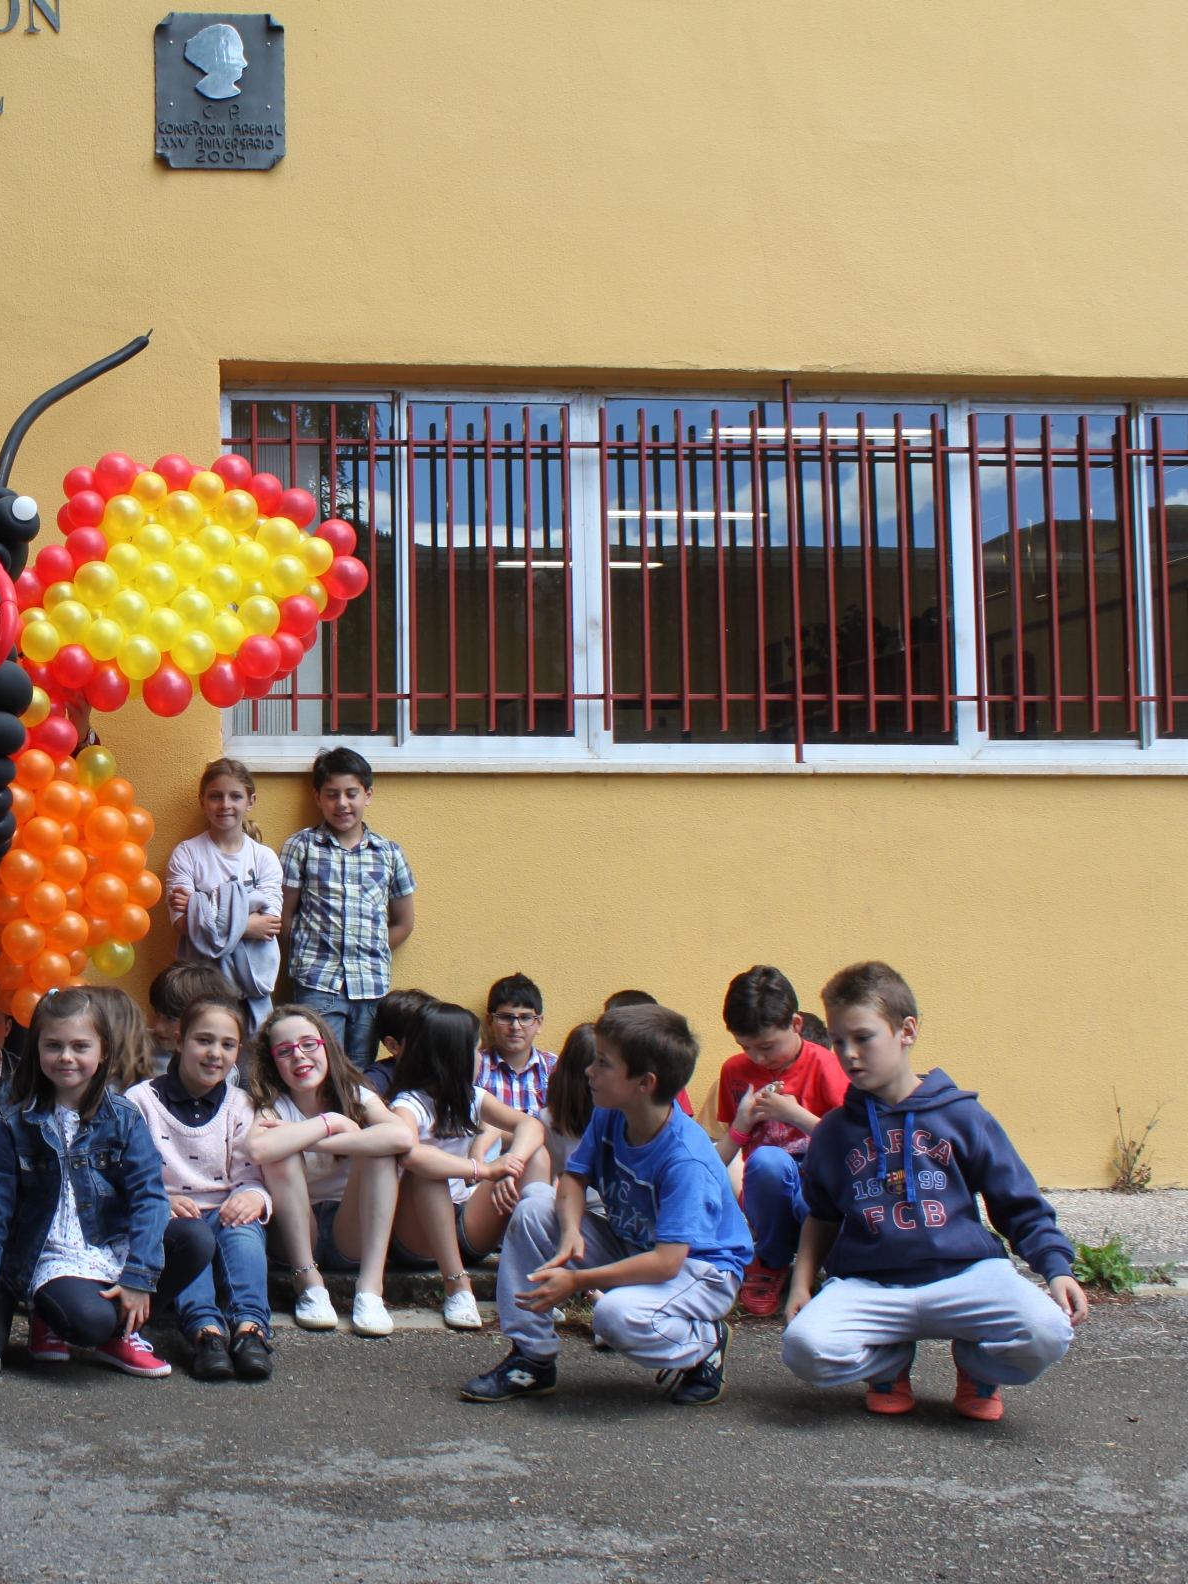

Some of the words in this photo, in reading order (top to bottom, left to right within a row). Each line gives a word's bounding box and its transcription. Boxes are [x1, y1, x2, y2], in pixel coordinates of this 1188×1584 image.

[157, 120, 226, 135] CONCEPCION
[232, 122, 283, 136] ARENAL
[160, 137, 190, 149] XXV
[195, 137, 274, 150] ANIVERSARIO
[195, 150, 246, 164] 2004
[853, 1178, 884, 1200] 18
[918, 1170, 947, 1190] 99
